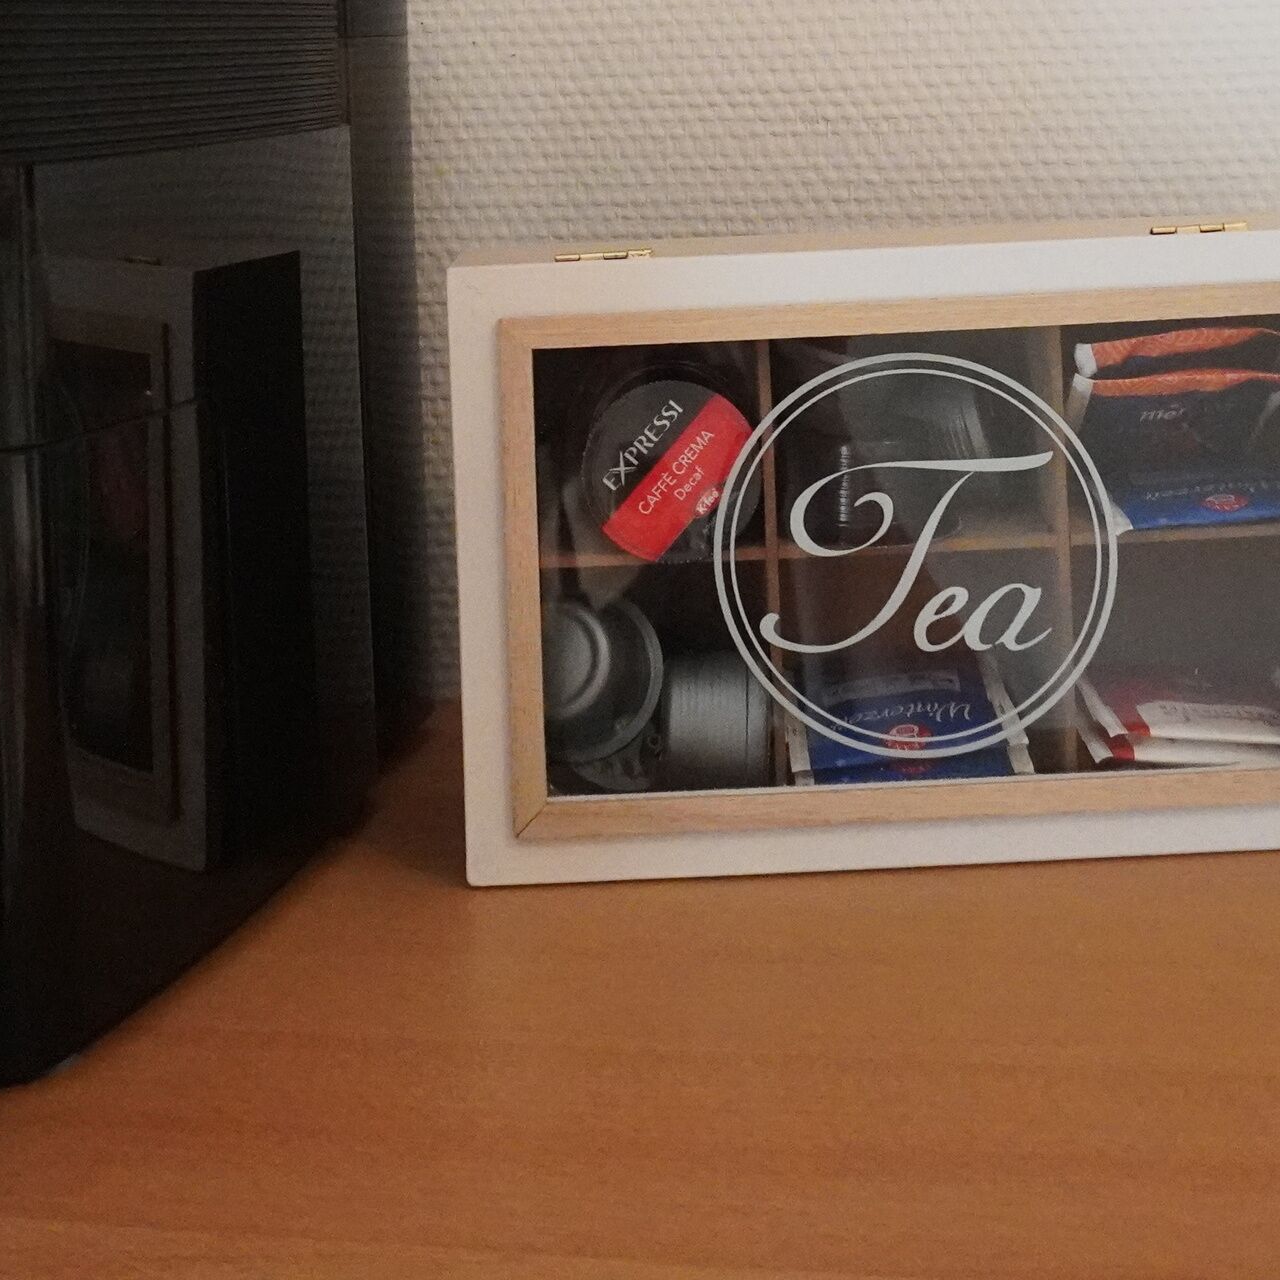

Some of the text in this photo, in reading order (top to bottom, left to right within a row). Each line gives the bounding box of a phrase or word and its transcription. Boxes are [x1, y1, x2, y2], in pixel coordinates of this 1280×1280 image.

[602, 399, 685, 491] EXPRESSI
[638, 471, 677, 516] CAFFÈ
[672, 429, 716, 476] CREMA
[674, 464, 706, 502] Decaf
[759, 450, 1054, 653] Tea
